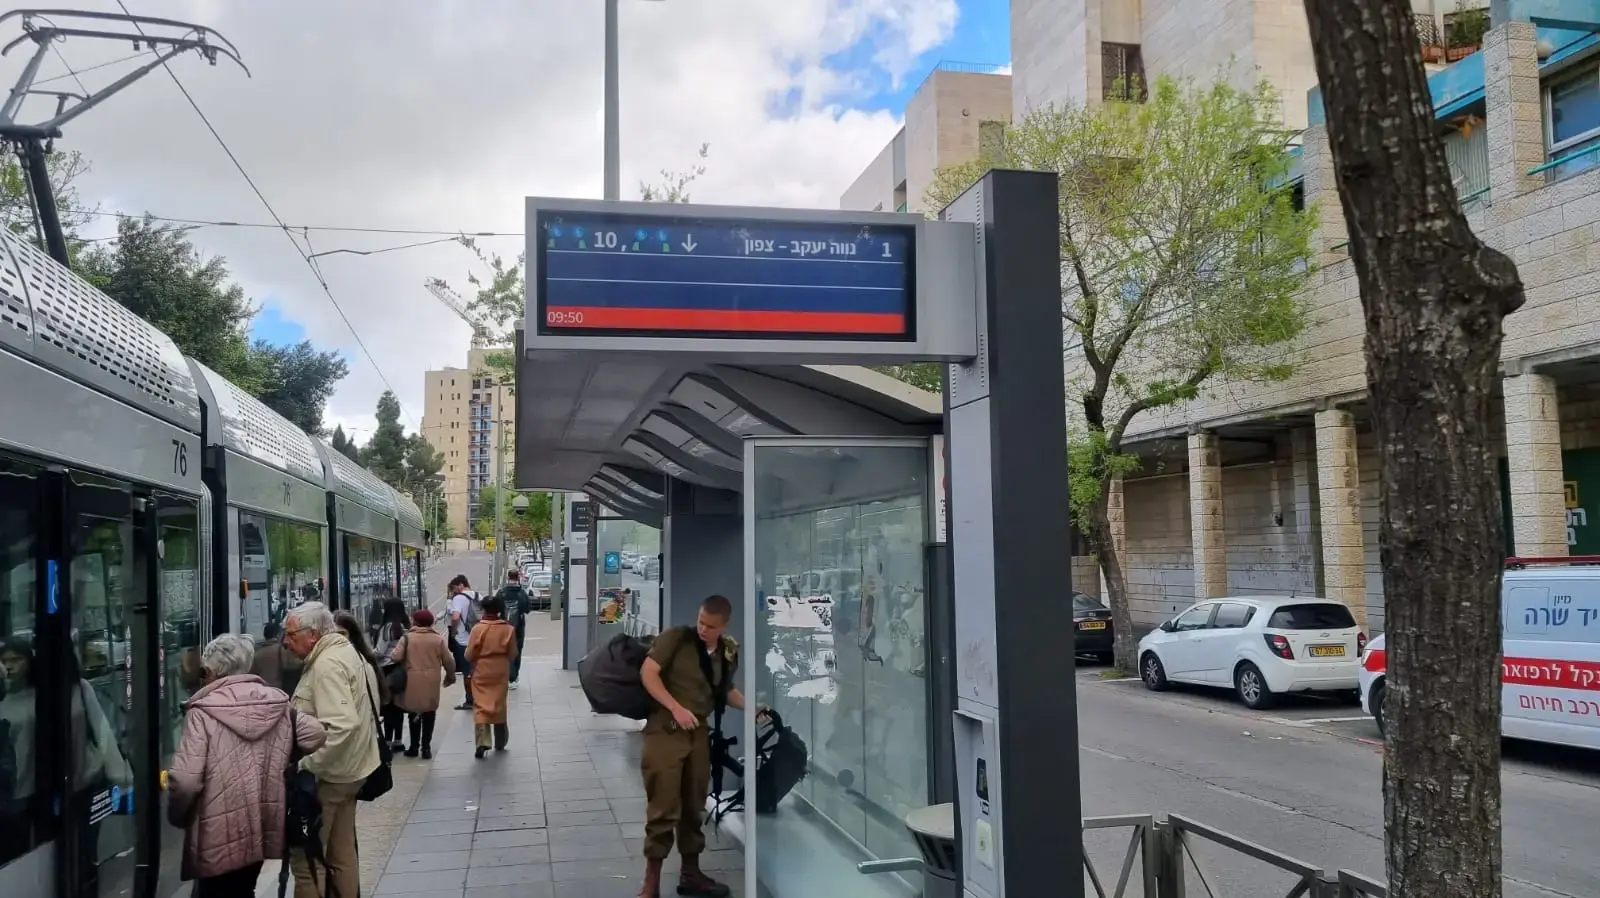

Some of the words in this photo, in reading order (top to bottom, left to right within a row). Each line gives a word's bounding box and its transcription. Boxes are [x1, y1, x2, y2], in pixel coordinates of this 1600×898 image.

[745, 239, 774, 255] צפון
[790, 240, 826, 256] יעקב
[830, 242, 856, 255] נווה
[881, 242, 892, 257] 1
[547, 311, 583, 323] 09:50
[172, 439, 187, 476] 76
[283, 481, 292, 507] 76
[1553, 595, 1572, 606] מיון
[1525, 607, 1569, 626] שרה
[1577, 608, 1598, 627] יד
[1519, 694, 1563, 713] חירום
